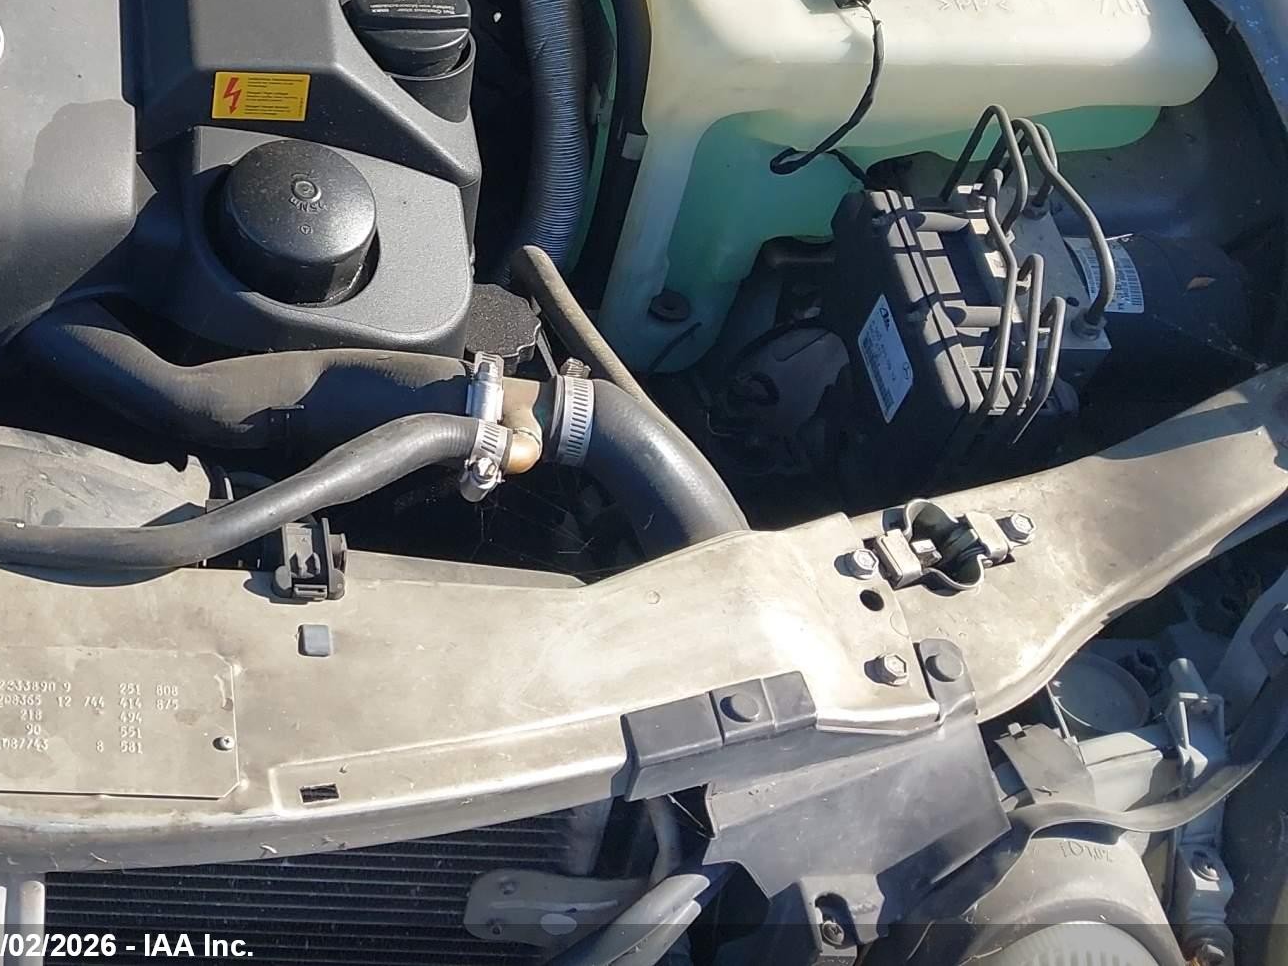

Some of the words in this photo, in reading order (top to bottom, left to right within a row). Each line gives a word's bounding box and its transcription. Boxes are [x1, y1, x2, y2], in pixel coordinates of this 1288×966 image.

[119, 683, 142, 696] 251
[56, 696, 72, 707] 12
[83, 696, 105, 708] 744
[118, 698, 143, 709] 414
[20, 709, 43, 721] 218
[119, 711, 143, 723] 494
[25, 724, 42, 735] 90
[120, 726, 143, 738] 551
[96, 741, 105, 753] 8
[120, 741, 144, 754] 581
